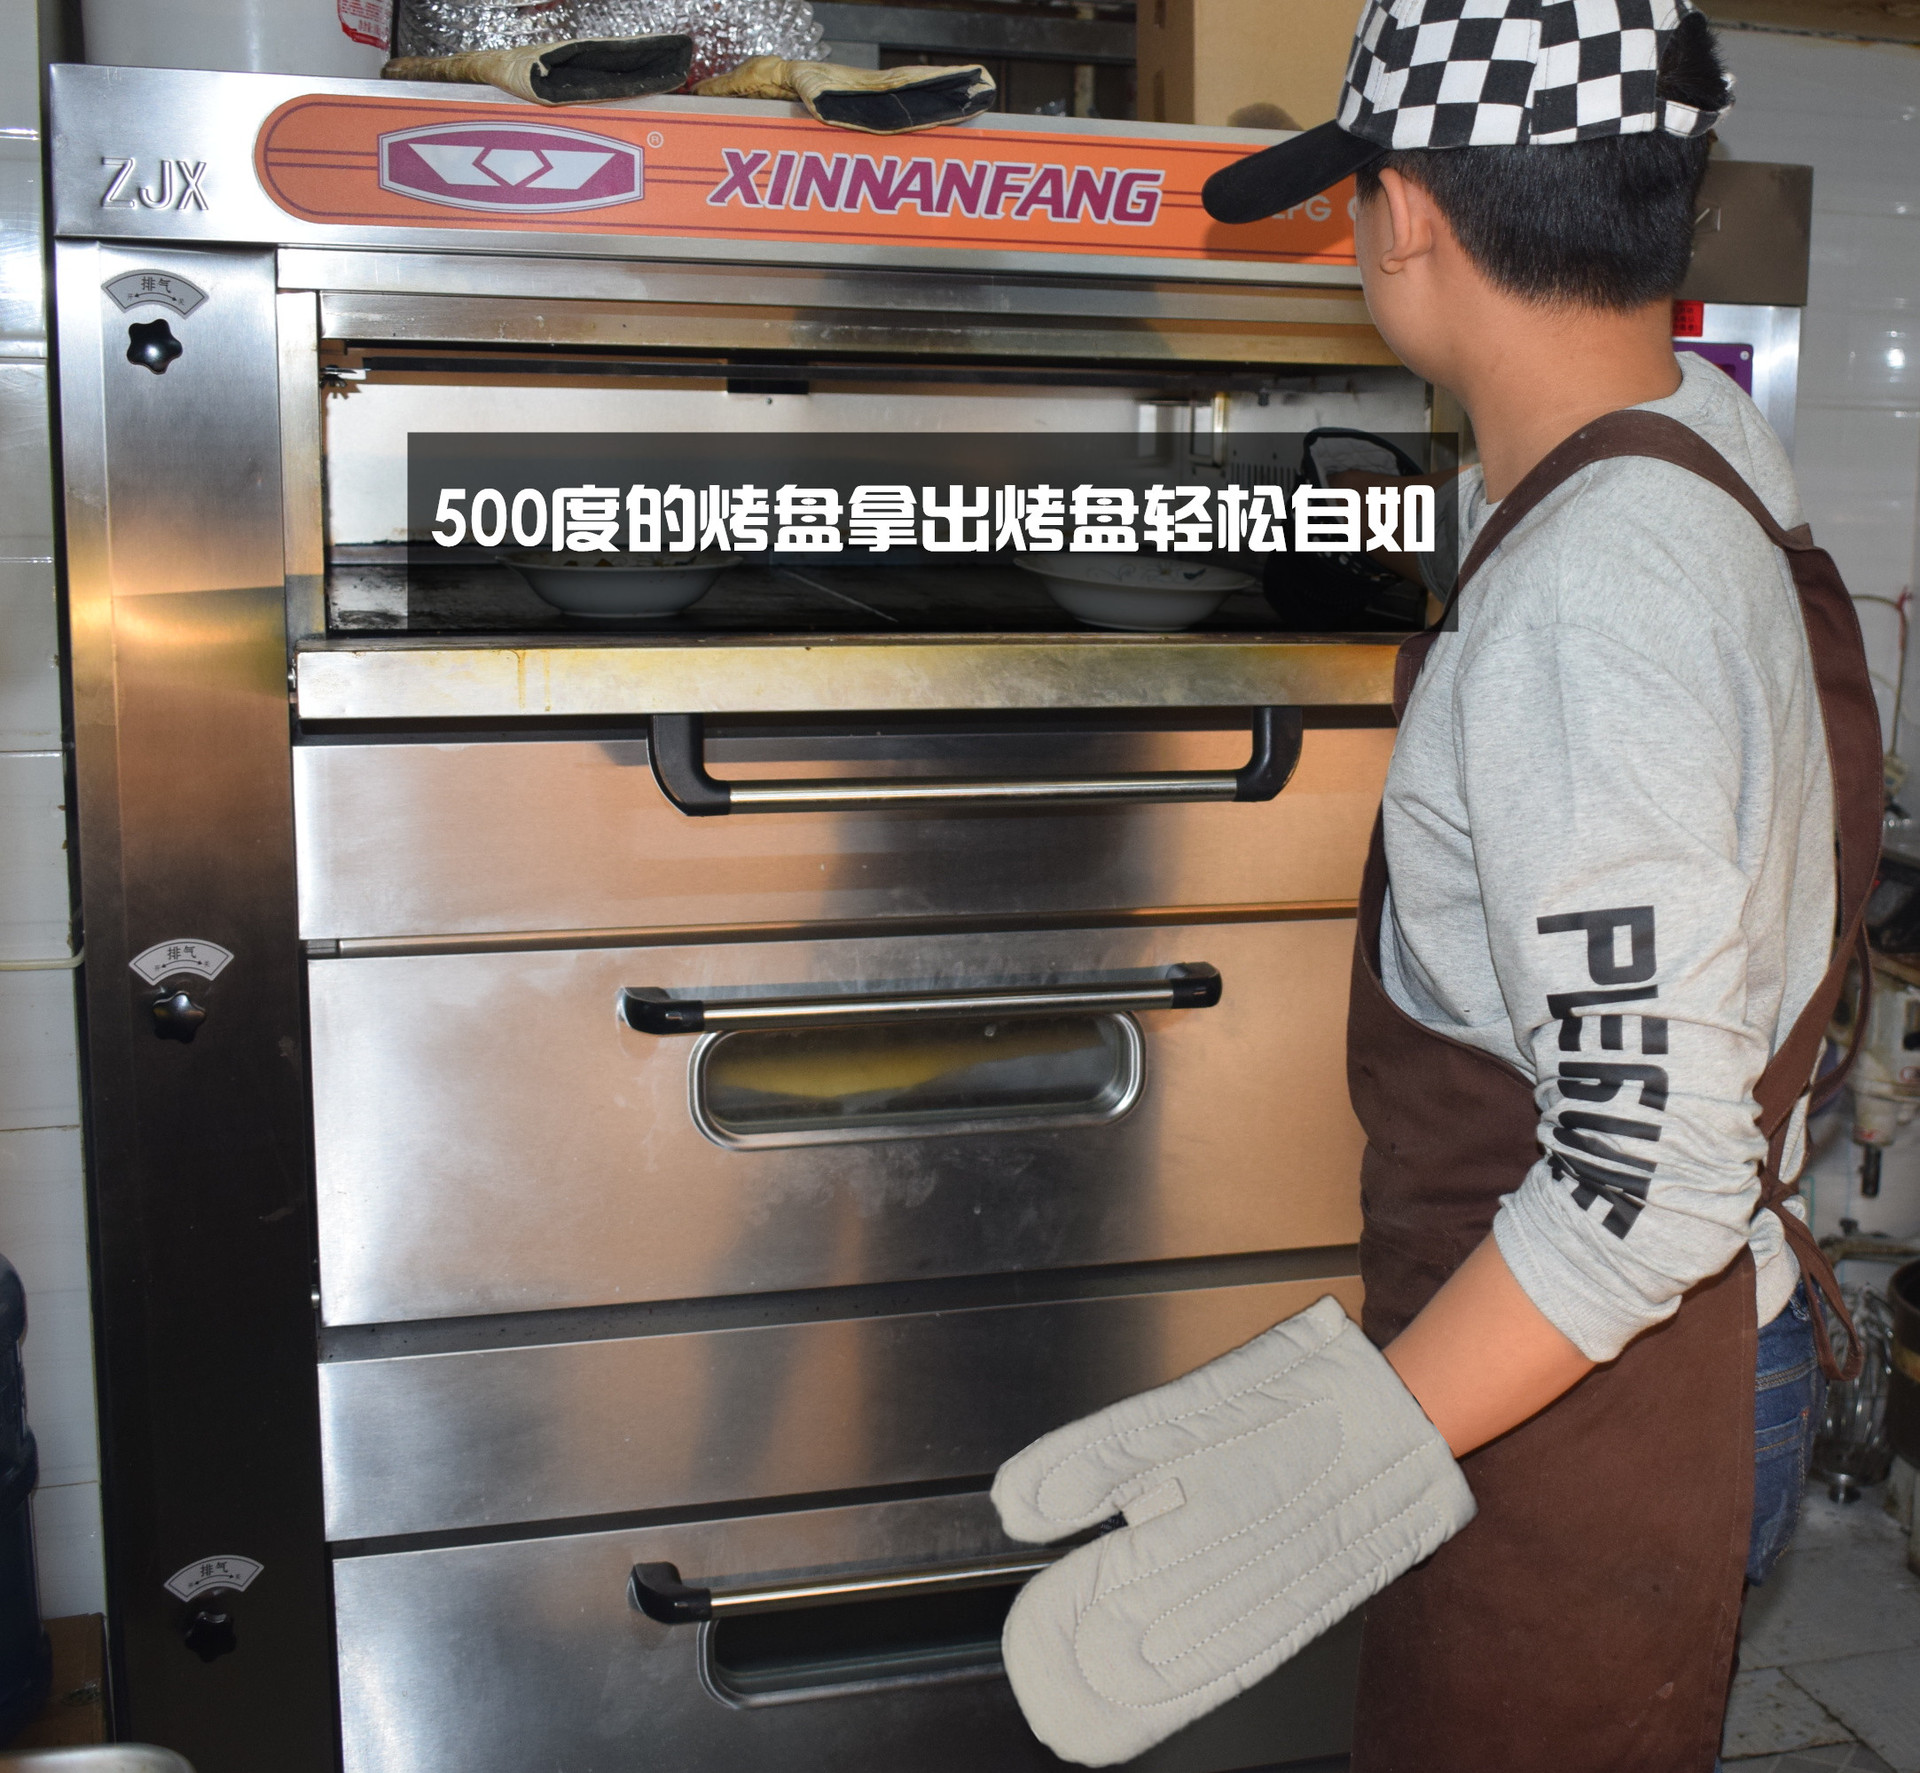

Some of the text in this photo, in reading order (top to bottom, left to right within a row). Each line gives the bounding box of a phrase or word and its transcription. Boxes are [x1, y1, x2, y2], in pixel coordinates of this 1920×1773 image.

[101, 157, 209, 211] ZJX
[706, 147, 1165, 227] XINNANFANG
[140, 275, 172, 294] 排气
[167, 945, 197, 960] 排气
[200, 1561, 229, 1577] 排气
